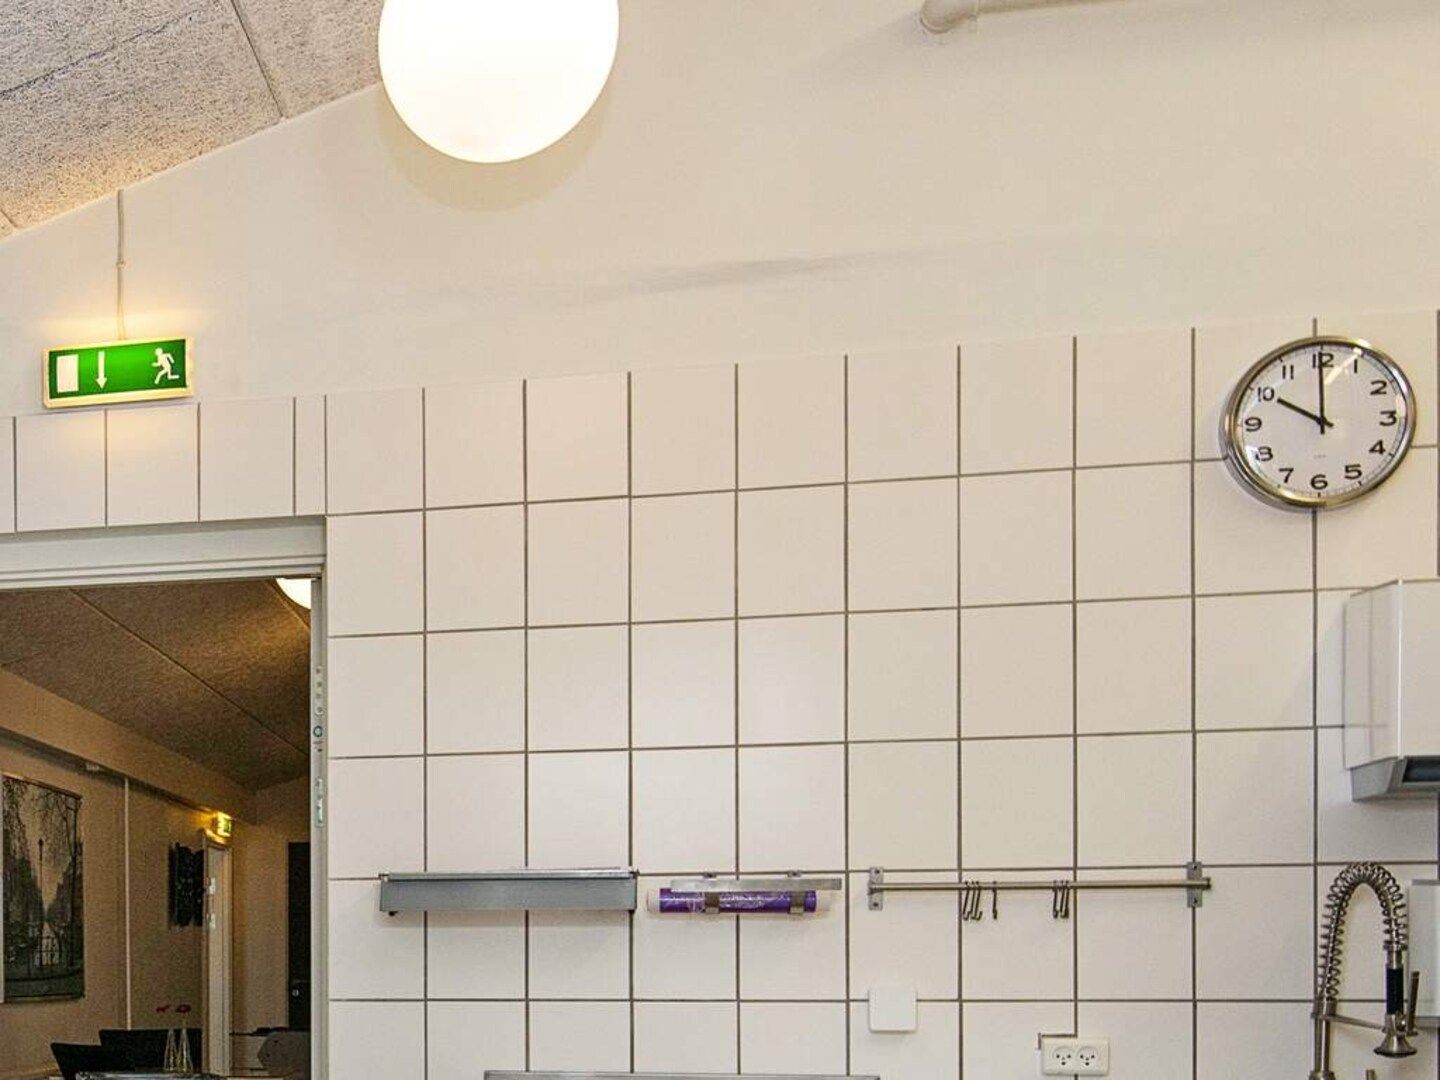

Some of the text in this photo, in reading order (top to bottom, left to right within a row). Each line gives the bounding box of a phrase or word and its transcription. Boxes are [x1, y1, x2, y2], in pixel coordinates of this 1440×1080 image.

[1312, 352, 1334, 368] 12
[1352, 359, 1359, 374] 1
[1281, 364, 1295, 380] 11
[1257, 386, 1276, 402] 10
[1370, 380, 1388, 396] 2
[1244, 416, 1263, 432] 9
[1379, 410, 1397, 427] 3
[1255, 446, 1274, 462] 8
[1368, 439, 1387, 456] 4
[1278, 467, 1295, 484] 7
[1344, 463, 1362, 480] 5
[1310, 474, 1329, 490] 6
